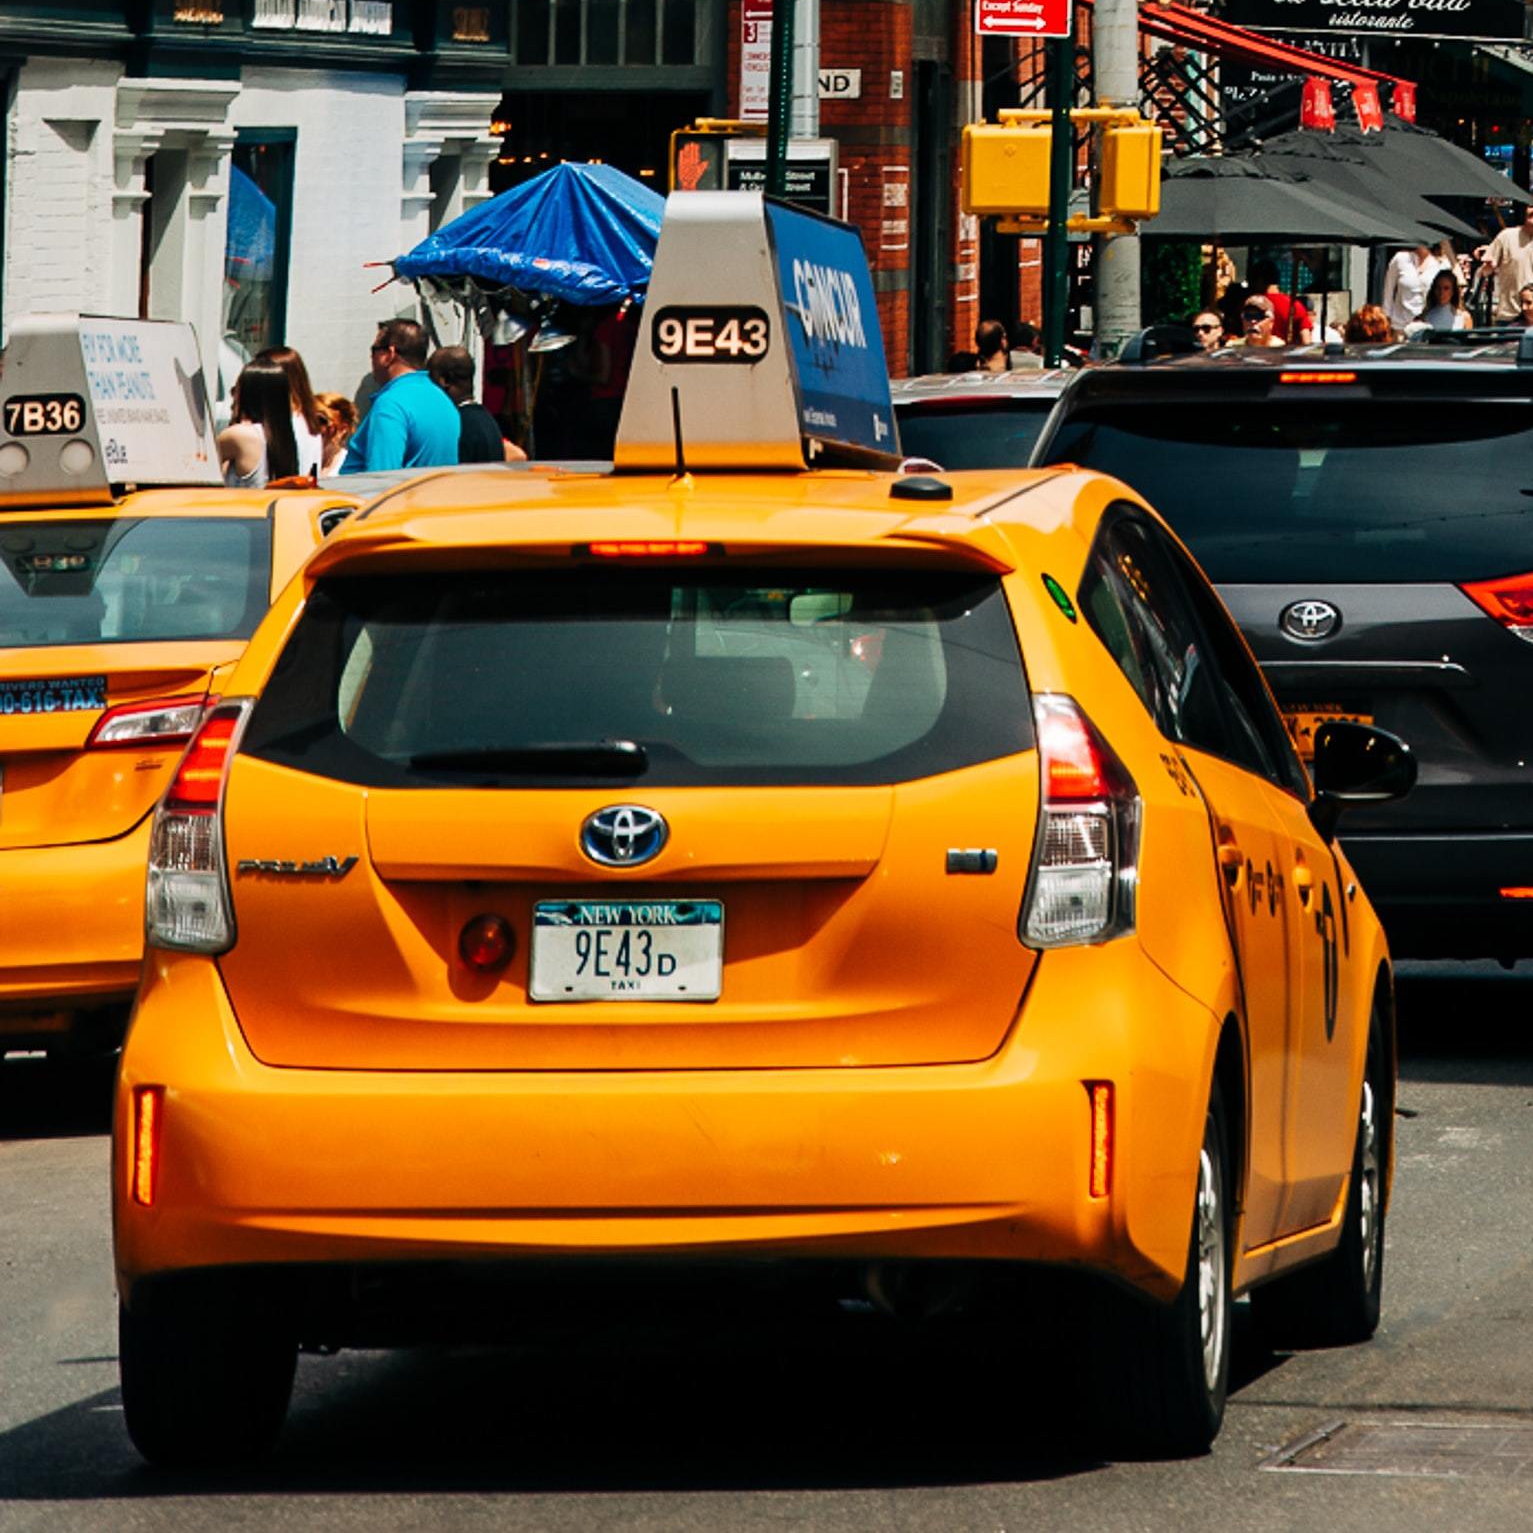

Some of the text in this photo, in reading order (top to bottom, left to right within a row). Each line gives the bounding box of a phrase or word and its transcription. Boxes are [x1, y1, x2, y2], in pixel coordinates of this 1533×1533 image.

[1329, 10, 1414, 29] ristorante
[659, 319, 767, 356] 9E43
[6, 401, 81, 433] 7B36
[580, 906, 676, 924] NEW YORK
[611, 980, 642, 990] TAXI
